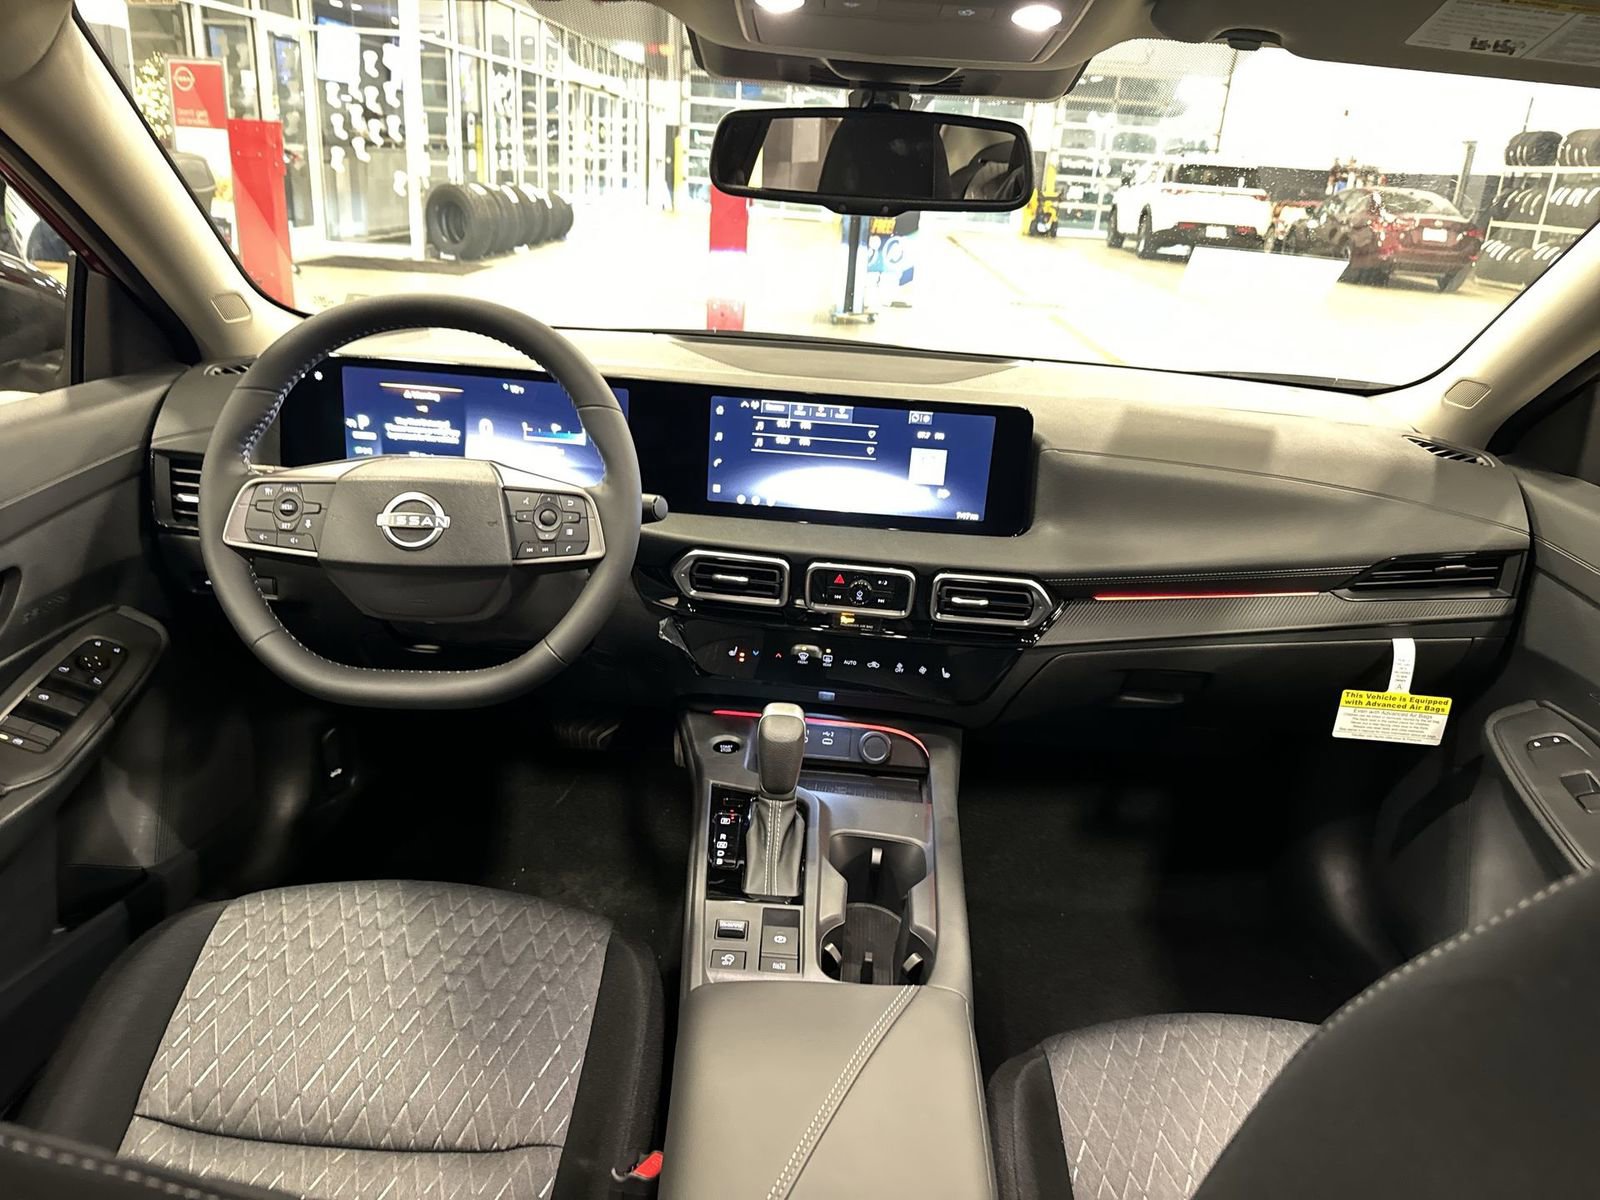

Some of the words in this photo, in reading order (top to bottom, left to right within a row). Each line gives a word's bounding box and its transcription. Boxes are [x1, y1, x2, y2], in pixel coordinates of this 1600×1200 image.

[379, 513, 449, 528] ISSAN
[1365, 701, 1407, 709] Advanced
[1366, 693, 1397, 701] Vehicle
[1409, 697, 1449, 706] Equipped
